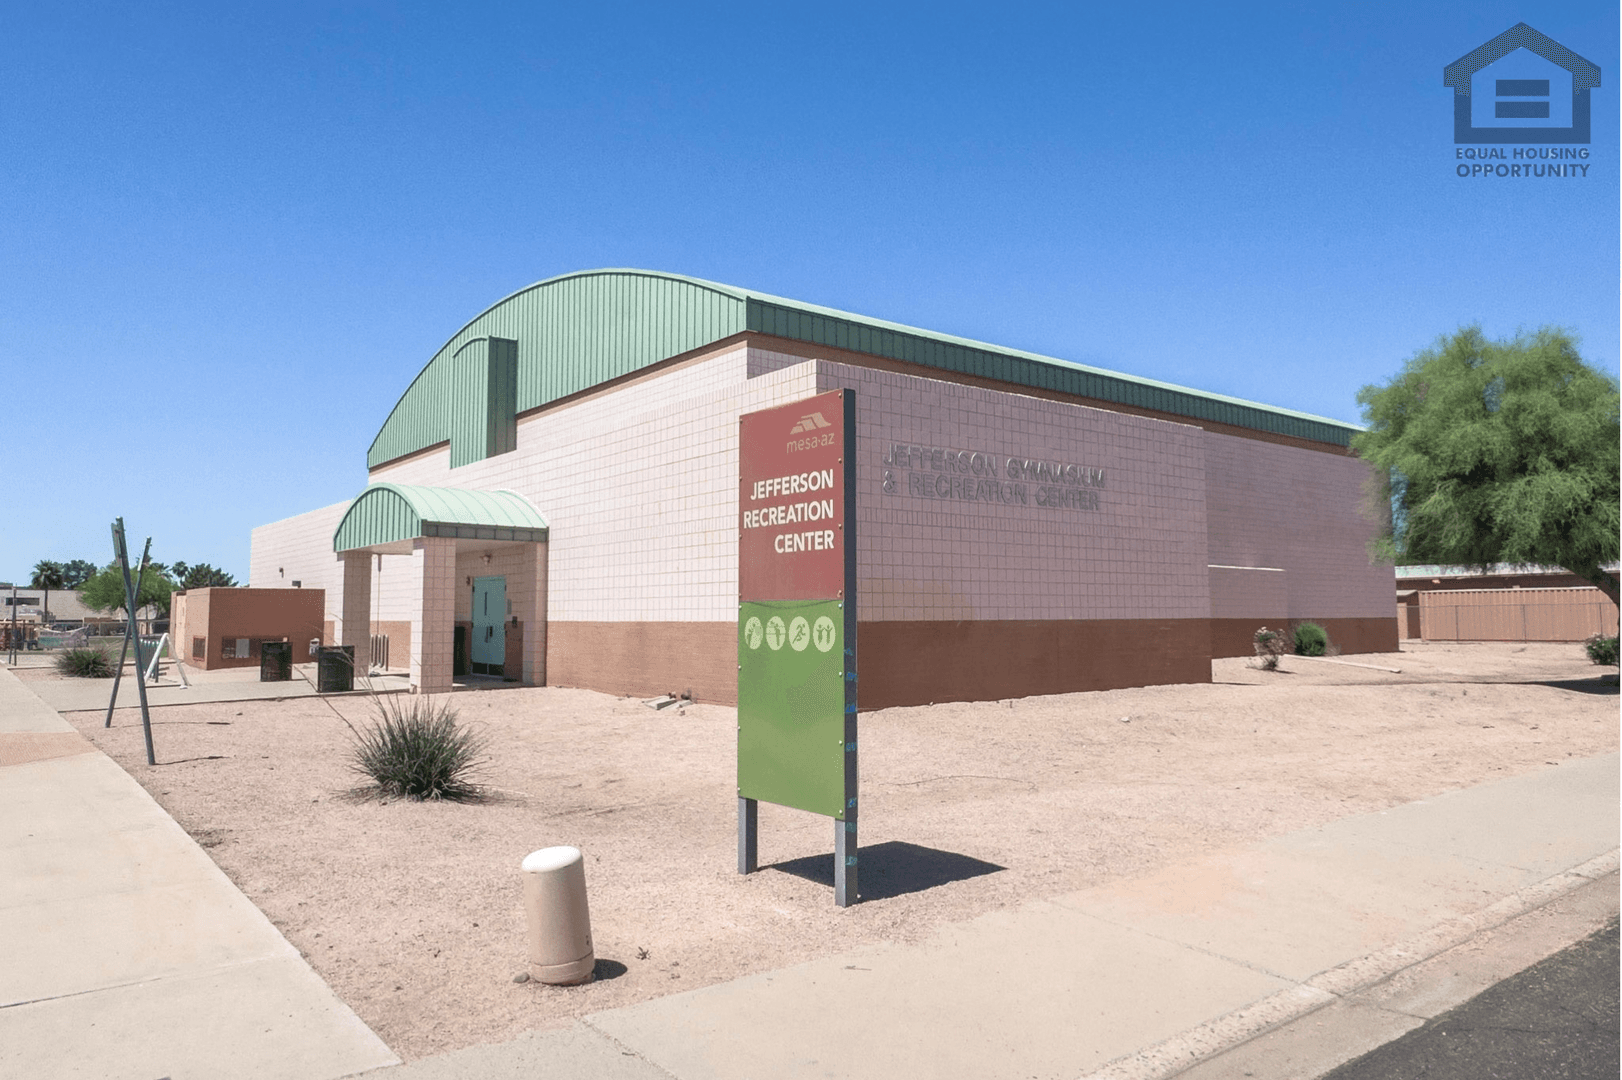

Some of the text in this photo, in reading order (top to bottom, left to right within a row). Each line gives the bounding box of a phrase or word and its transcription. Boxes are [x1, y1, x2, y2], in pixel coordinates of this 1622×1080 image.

[883, 442, 1105, 488] JEFFERSON GYMNASIUM
[750, 469, 834, 501] JEFFERSON
[883, 470, 1099, 511] & RECREATION CENTER
[743, 499, 834, 529] RECREATION
[774, 530, 835, 554] CENTER
